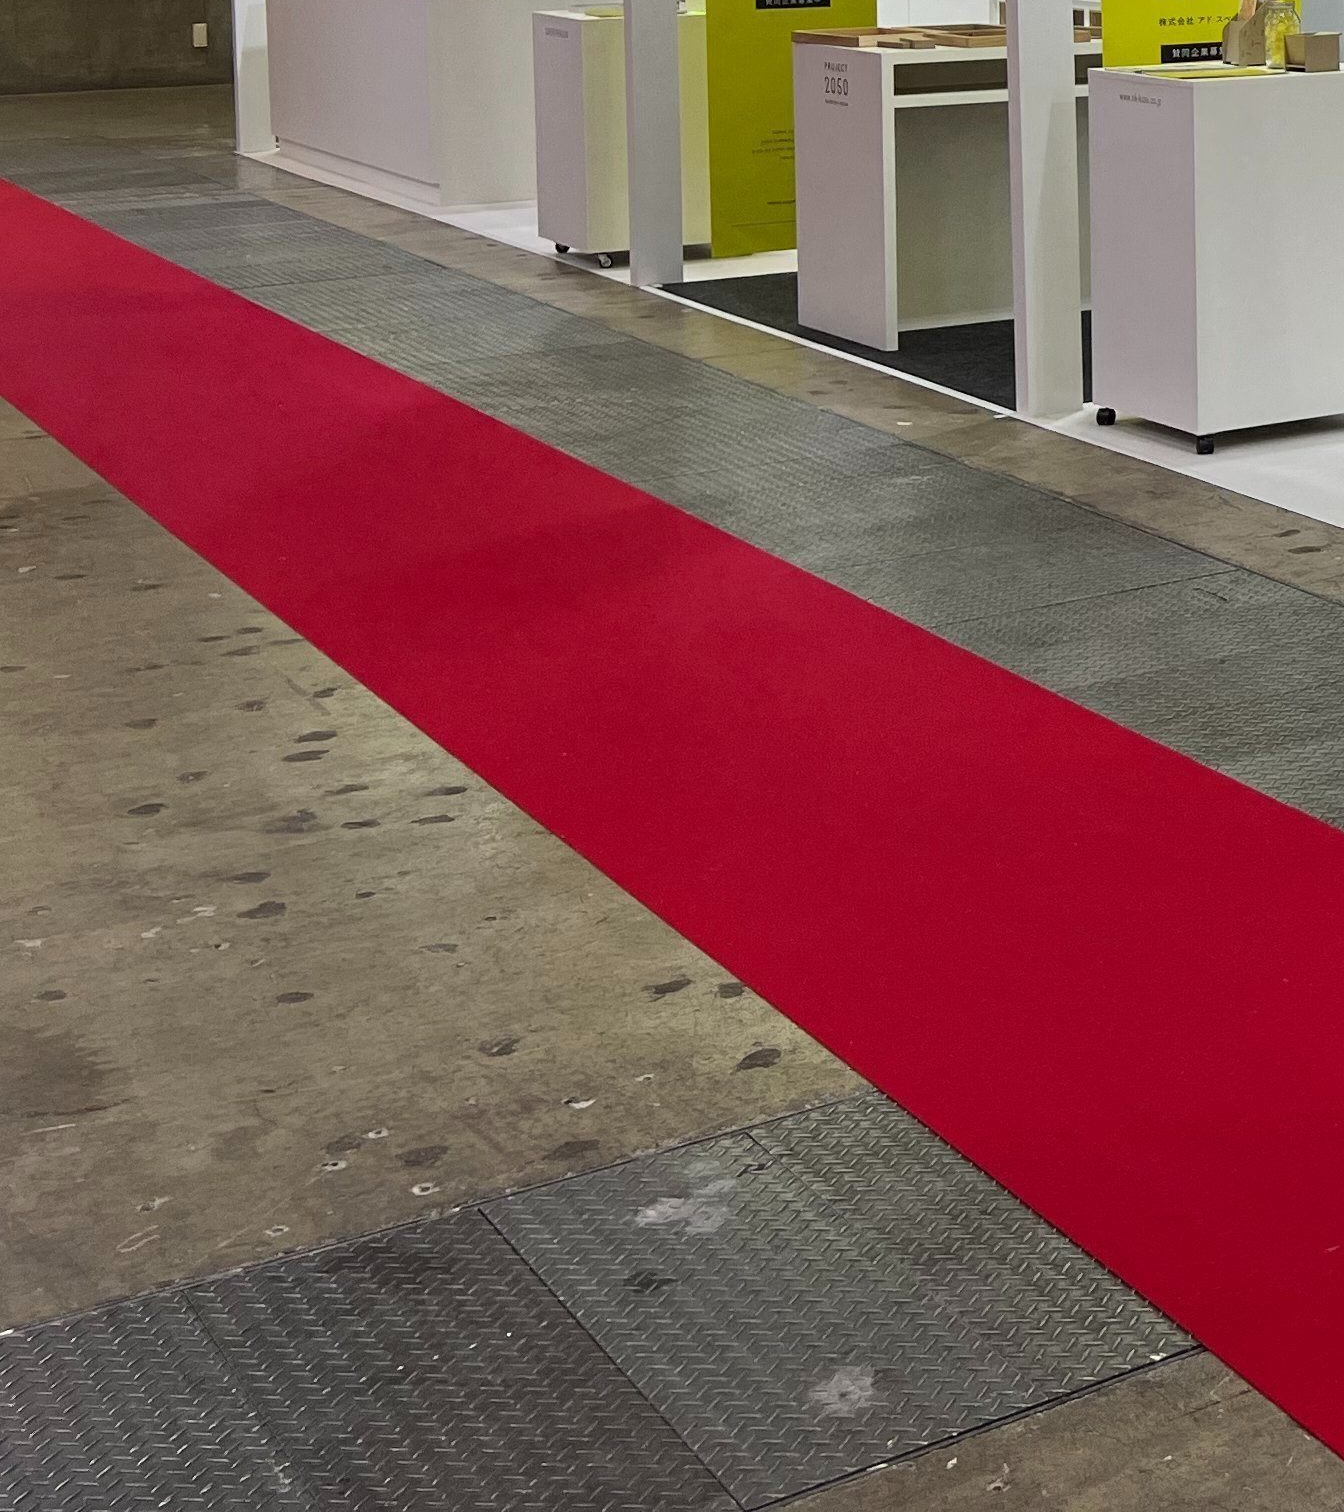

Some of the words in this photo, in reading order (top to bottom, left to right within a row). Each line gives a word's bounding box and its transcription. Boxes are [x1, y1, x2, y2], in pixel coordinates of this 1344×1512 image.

[1158, 16, 1194, 27] 株式会社
[824, 76, 848, 96] 2050
